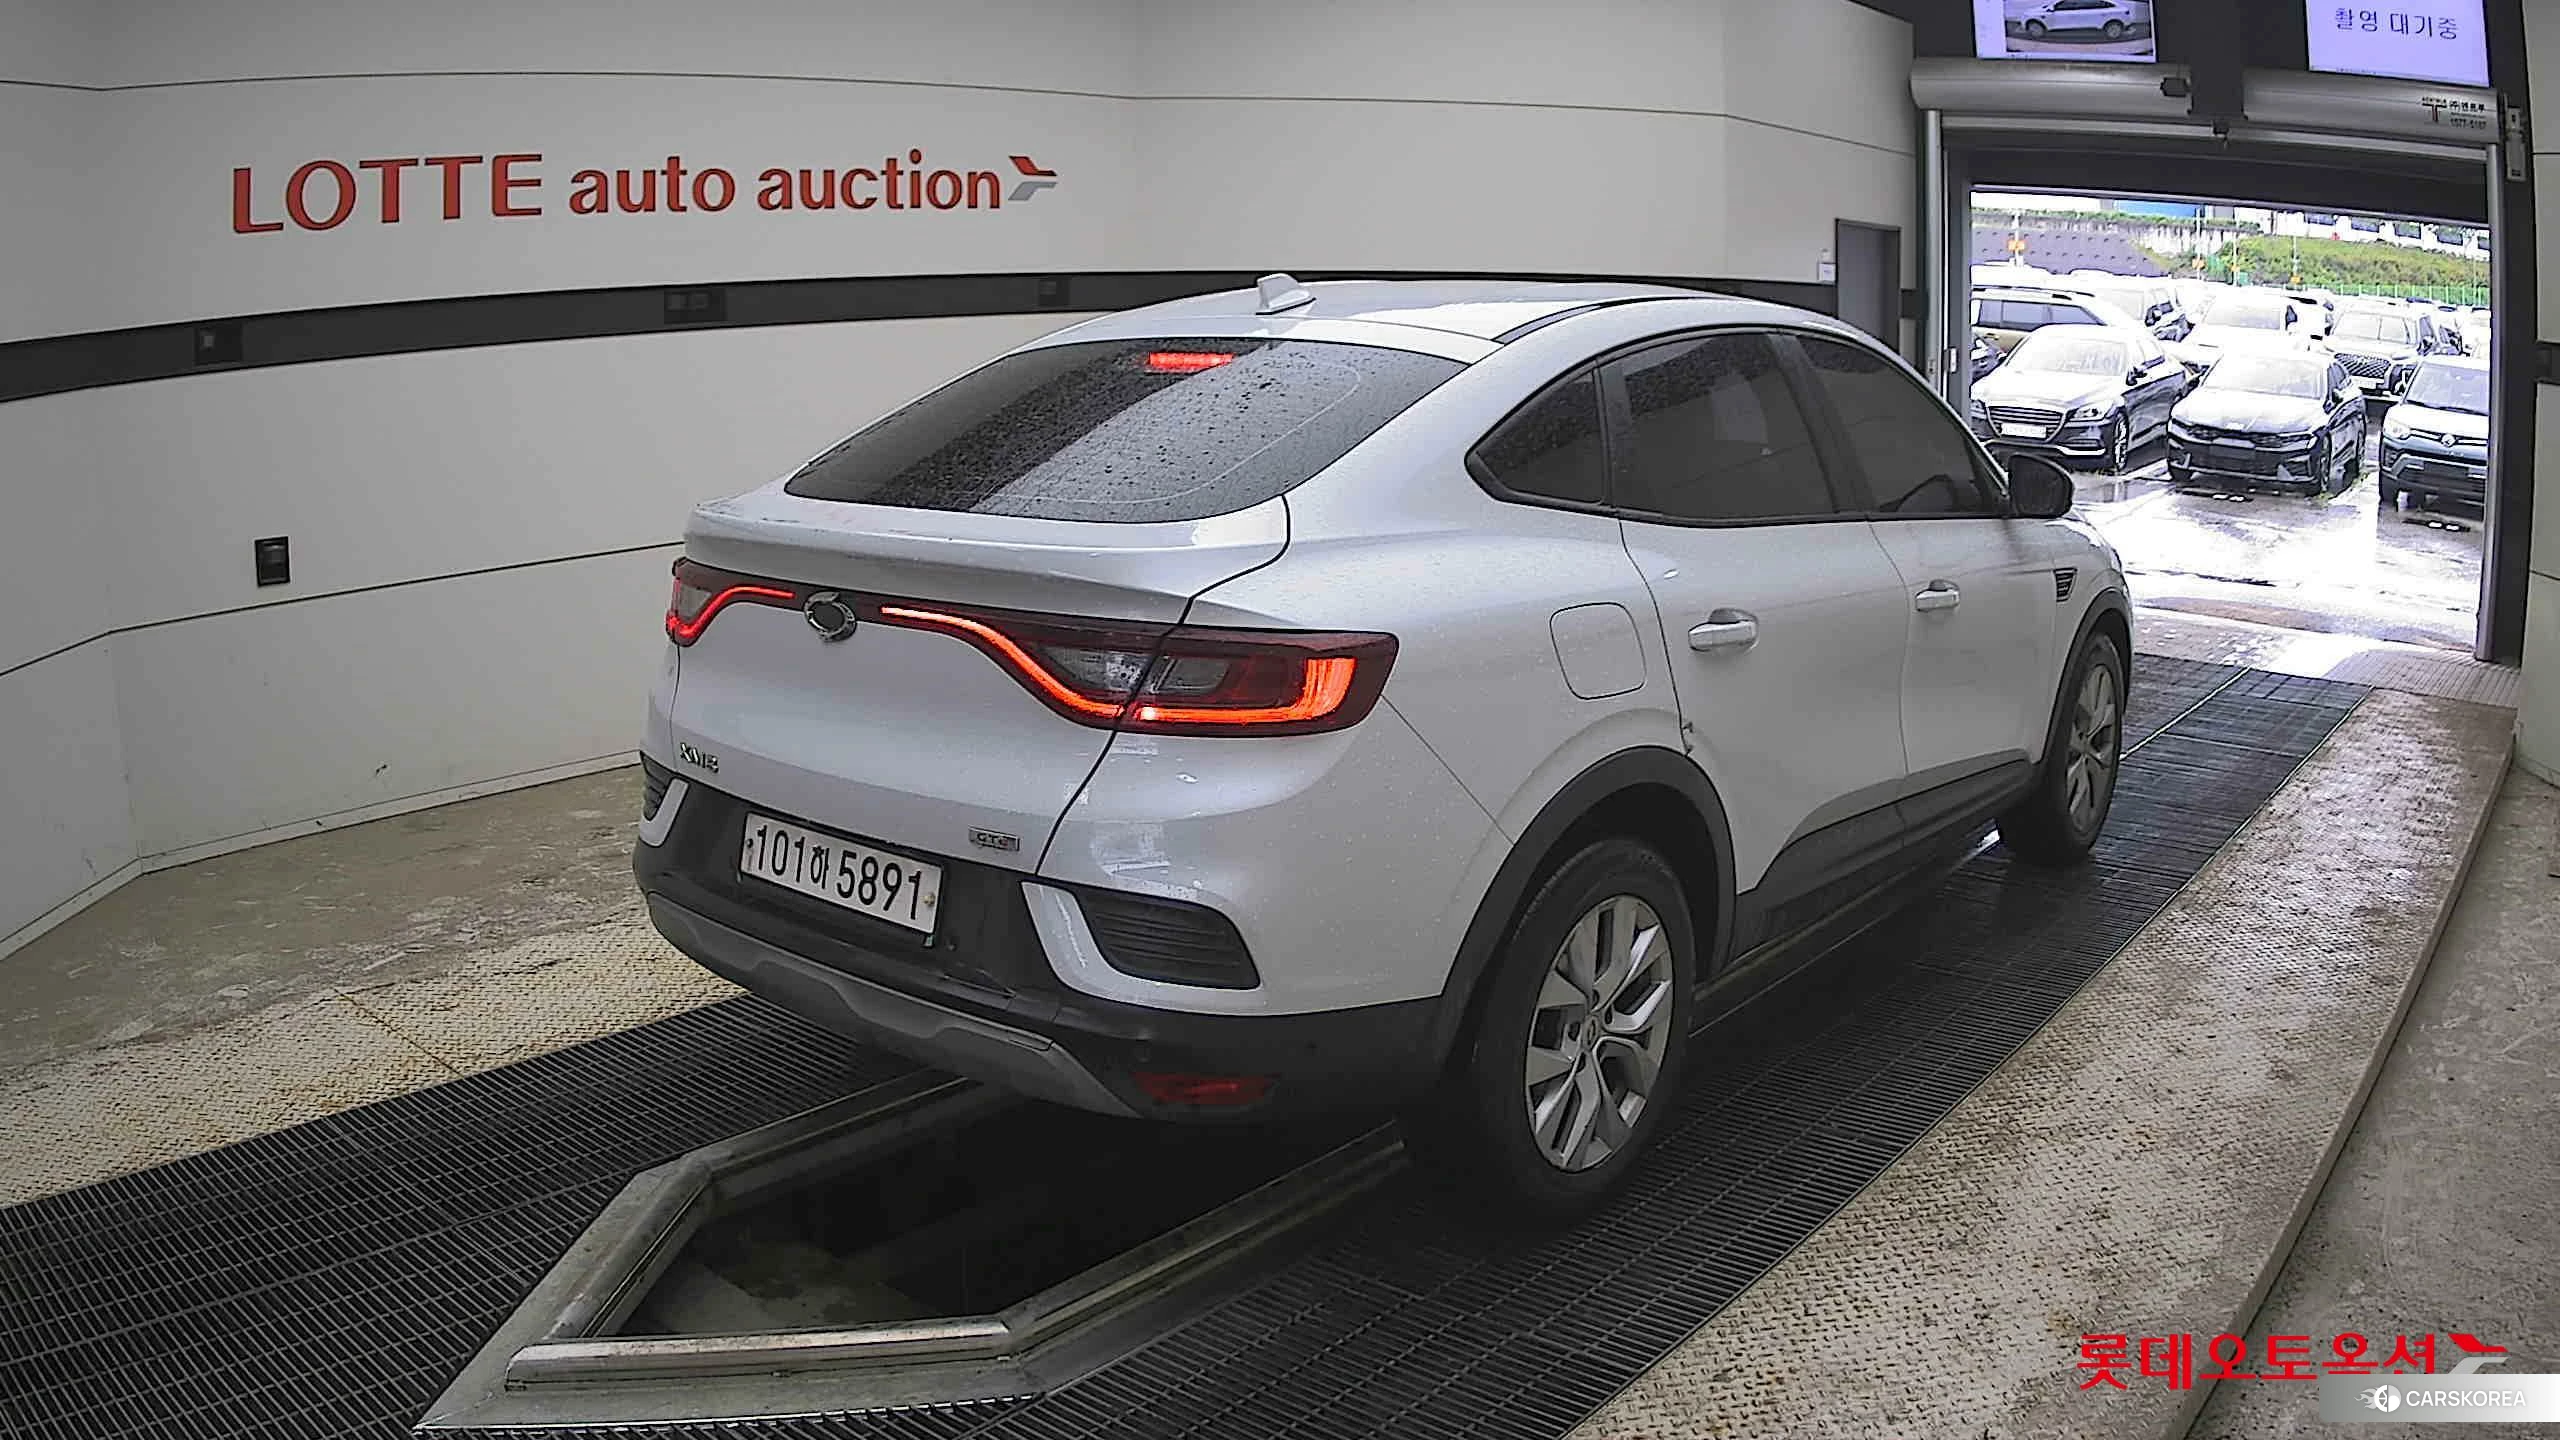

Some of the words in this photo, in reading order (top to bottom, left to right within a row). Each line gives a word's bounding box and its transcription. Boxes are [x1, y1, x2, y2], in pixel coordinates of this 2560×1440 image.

[2335, 7, 2379, 33] 촬영
[2389, 12, 2458, 41] 대기중
[231, 153, 543, 234] LOTTE
[568, 158, 737, 214] auto
[757, 148, 1001, 212] auction
